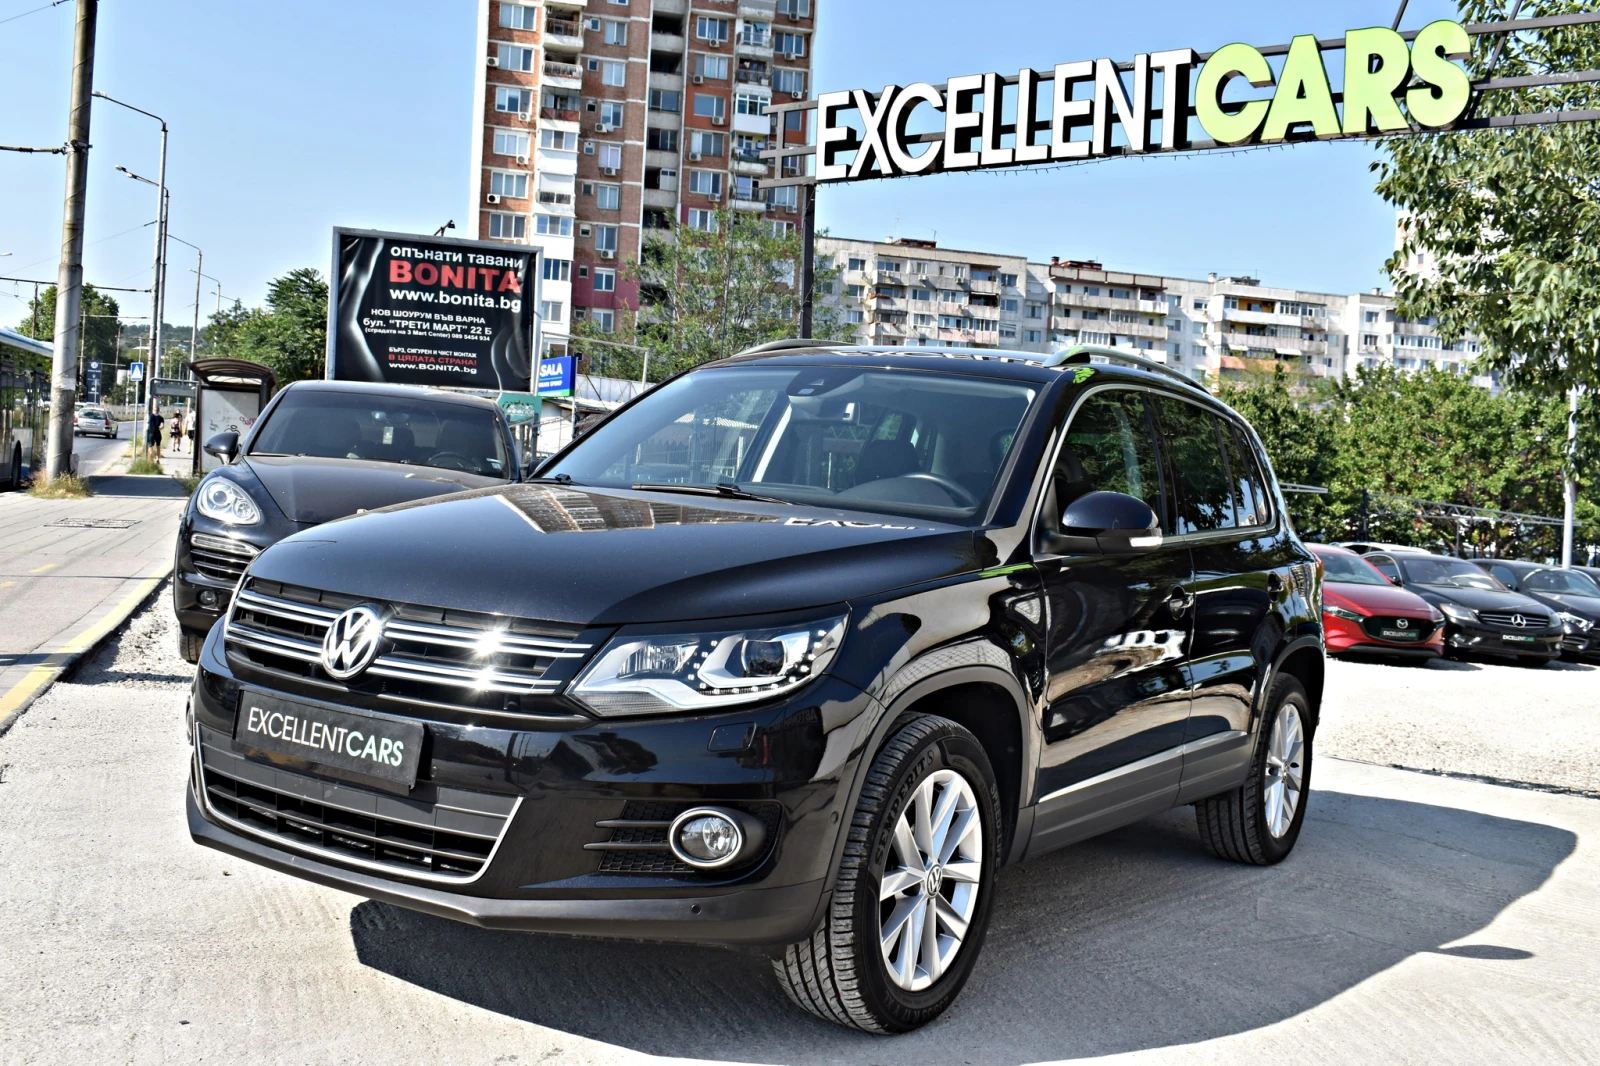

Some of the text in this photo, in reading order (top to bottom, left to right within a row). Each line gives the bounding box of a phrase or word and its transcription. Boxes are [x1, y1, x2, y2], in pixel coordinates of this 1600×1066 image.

[815, 19, 1474, 183] EXCELLENTCARS
[390, 246, 523, 269] опънати тавани
[389, 259, 522, 294] BONITA
[389, 288, 522, 313] www.bonita.bg
[363, 318, 386, 327] бул.
[470, 326, 482, 334] 22
[484, 327, 492, 335] Б
[393, 309, 432, 319] ШОУРУМ
[434, 313, 454, 321] ВЪВ
[455, 315, 486, 324] ВАРНА
[389, 363, 477, 374] www.BONITA.bg
[397, 354, 435, 364] ЦЯЛАТА
[437, 357, 477, 366] СТРАНА!
[247, 706, 404, 767] EXCELLENTCARS
[875, 757, 926, 865] SEMPERIT
